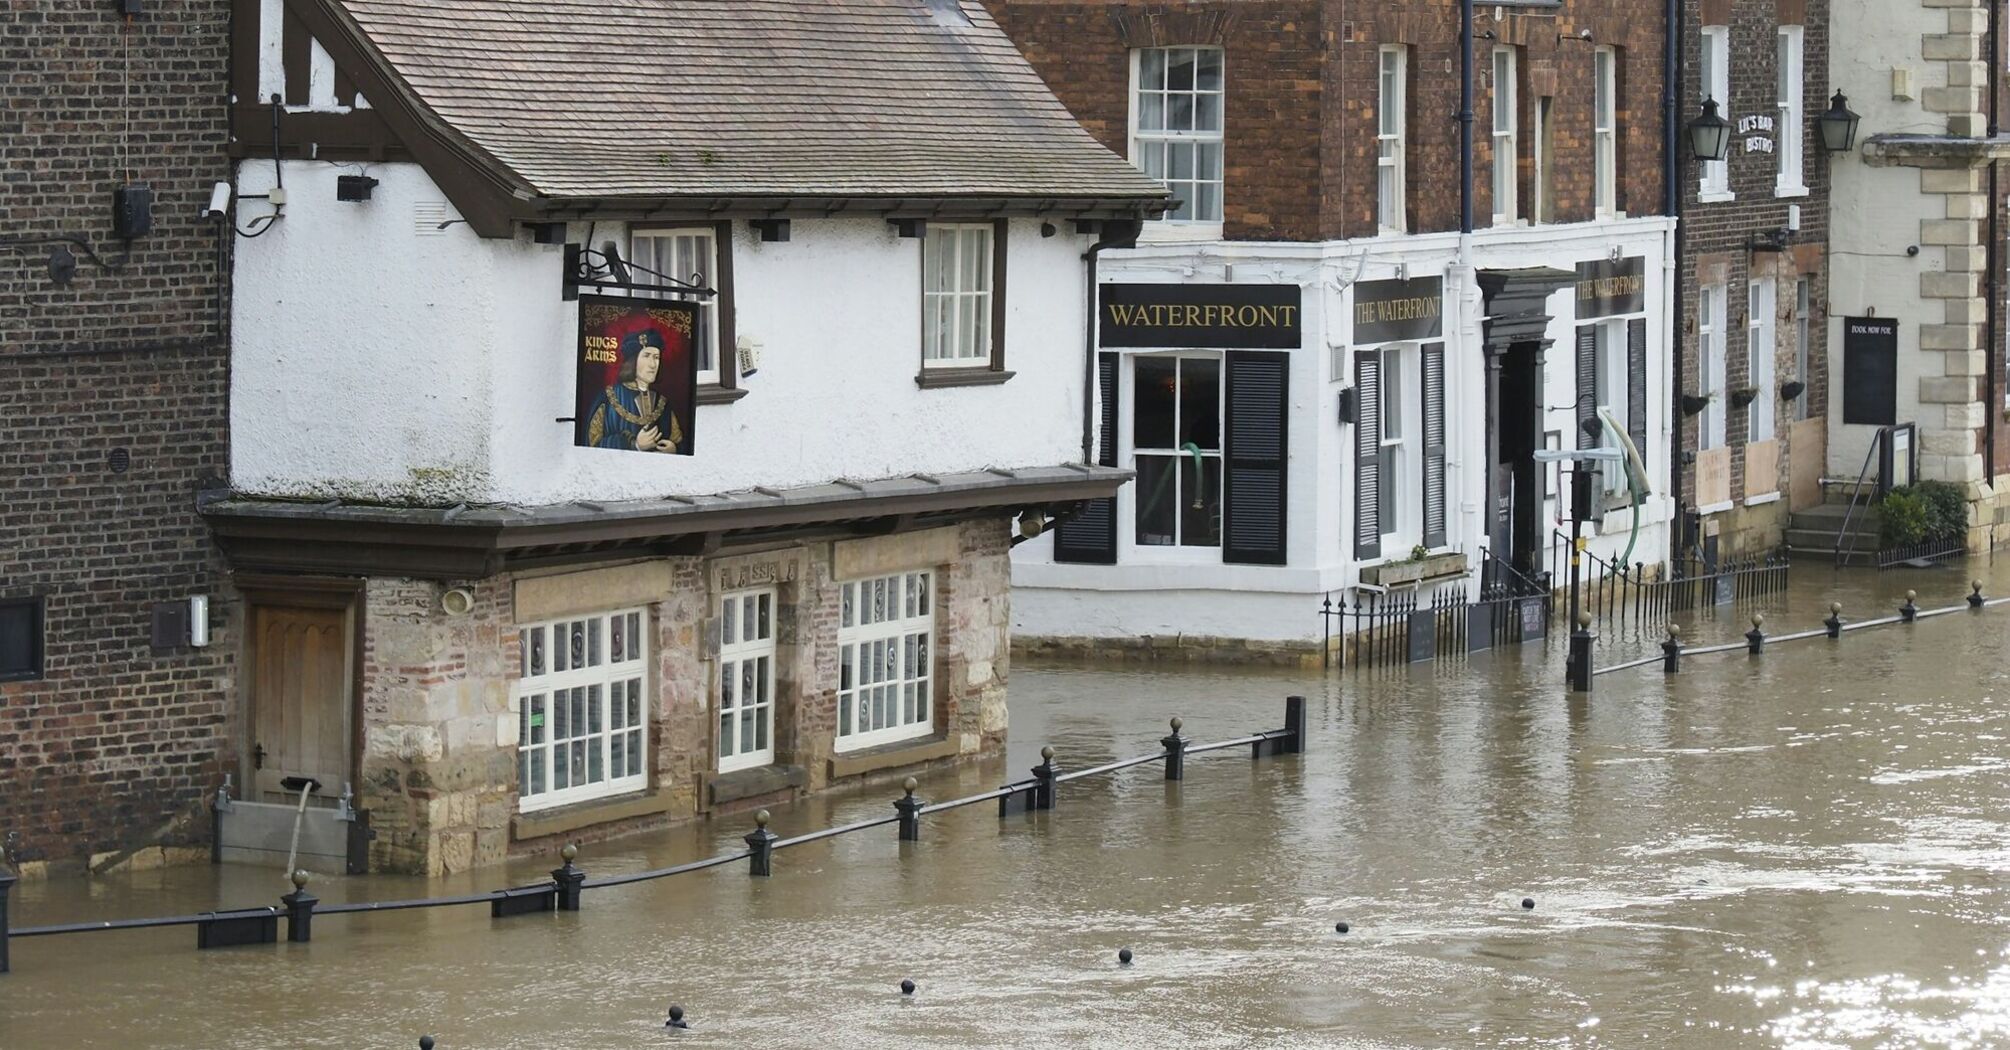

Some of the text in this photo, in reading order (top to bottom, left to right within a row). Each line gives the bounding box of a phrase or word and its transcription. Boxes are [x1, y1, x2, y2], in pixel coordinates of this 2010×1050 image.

[1758, 115, 1773, 132] BAR
[1746, 137, 1773, 153] BISTRO
[1577, 275, 1644, 301] THE WATERFRONT
[1108, 304, 1297, 327] WATERFRONT
[1355, 296, 1441, 324] THE WATERFRONT
[1852, 325, 1892, 335] BOOK NOW FOR
[585, 335, 618, 349] KINGS
[584, 347, 617, 363] ARMS
